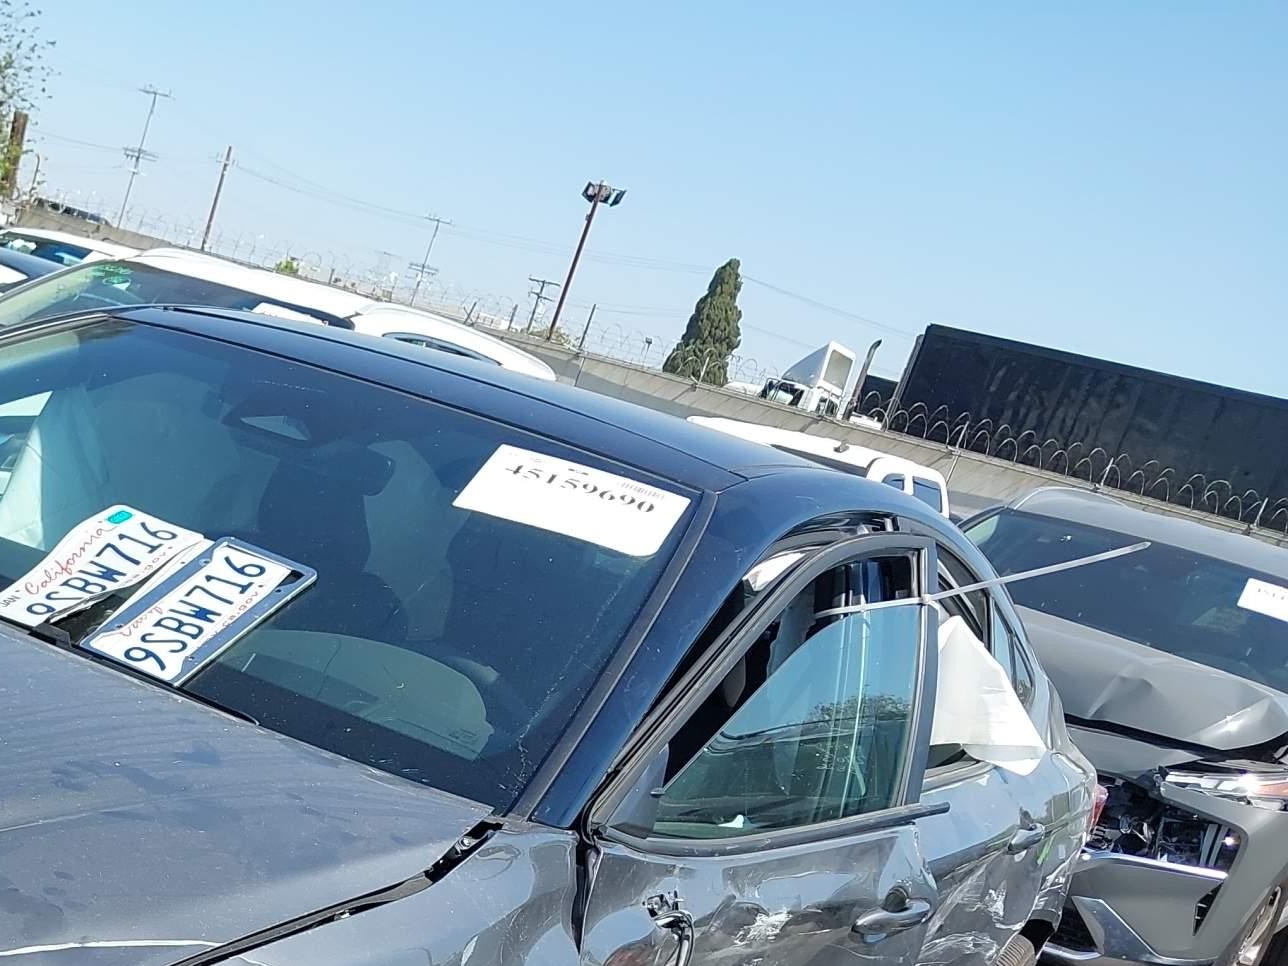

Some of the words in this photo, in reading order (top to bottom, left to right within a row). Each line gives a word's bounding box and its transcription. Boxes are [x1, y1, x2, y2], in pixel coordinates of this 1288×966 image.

[505, 465, 655, 513] 45159690
[0, 595, 21, 608] JAN
[24, 523, 114, 596] California
[26, 521, 179, 616] 9SBW716
[124, 556, 267, 672] 9SBW716
